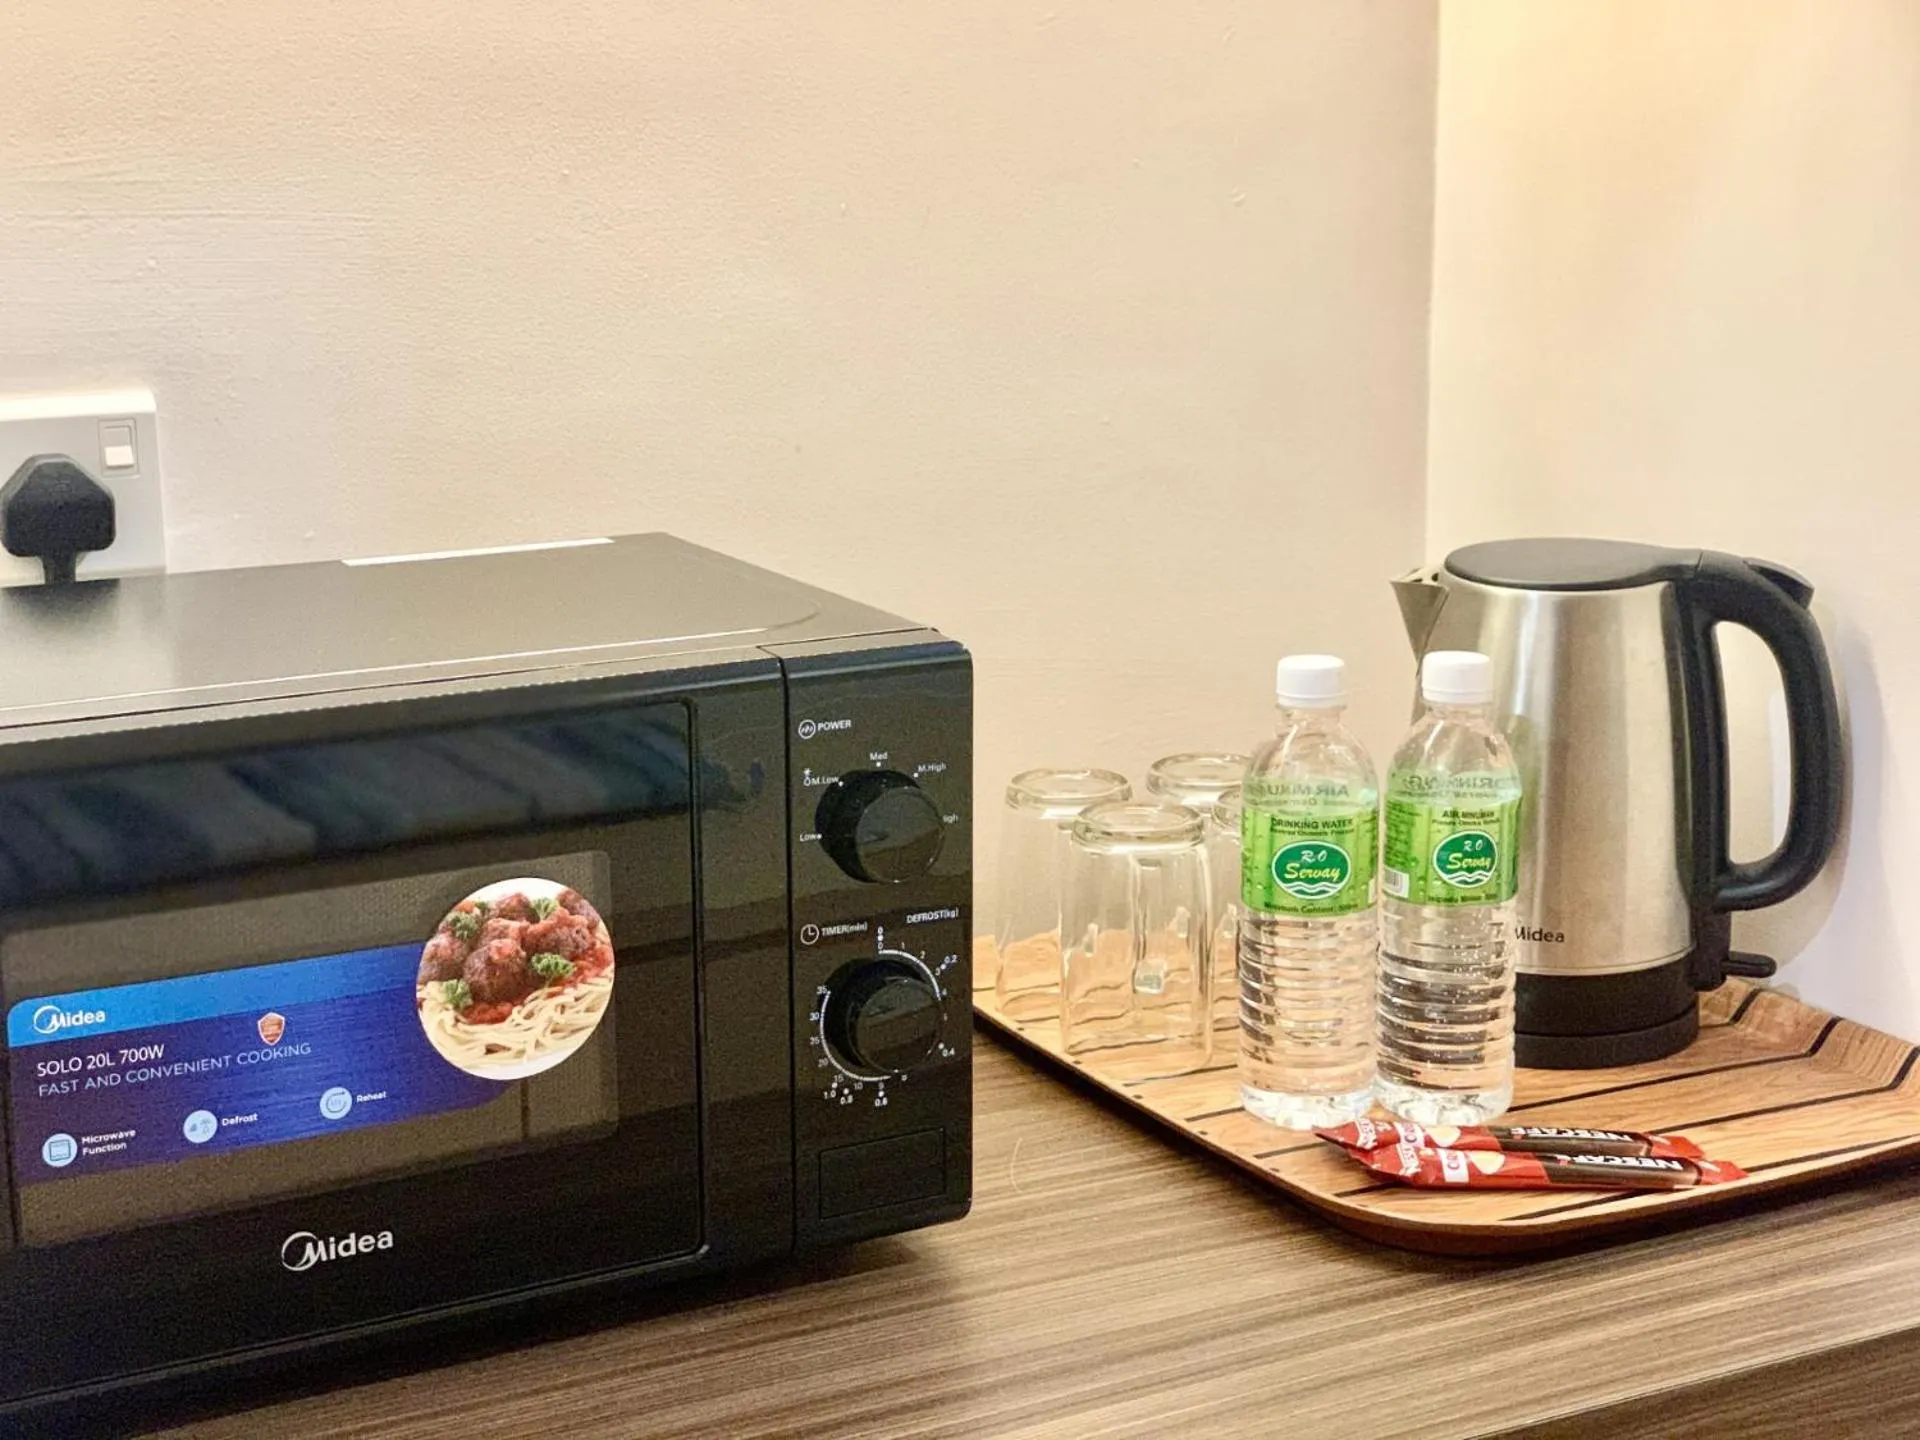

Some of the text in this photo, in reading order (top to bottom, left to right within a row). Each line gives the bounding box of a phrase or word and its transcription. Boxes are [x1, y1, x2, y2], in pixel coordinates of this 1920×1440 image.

[817, 719, 852, 731] POWER
[869, 752, 888, 761] Med
[1271, 815, 1319, 829] DRINKING
[800, 833, 816, 842] Low
[1284, 862, 1341, 882] Serway
[33, 1005, 106, 1034] Midea
[36, 1043, 165, 1077] SOLO 20L 700W
[38, 1042, 312, 1097] FAST AND CONVENIENT COOKING
[356, 1090, 387, 1103] Reheat
[221, 1113, 258, 1126] Defrost
[81, 1128, 137, 1145] Microwave
[82, 1141, 128, 1156] Function
[281, 1230, 394, 1272] Midea
